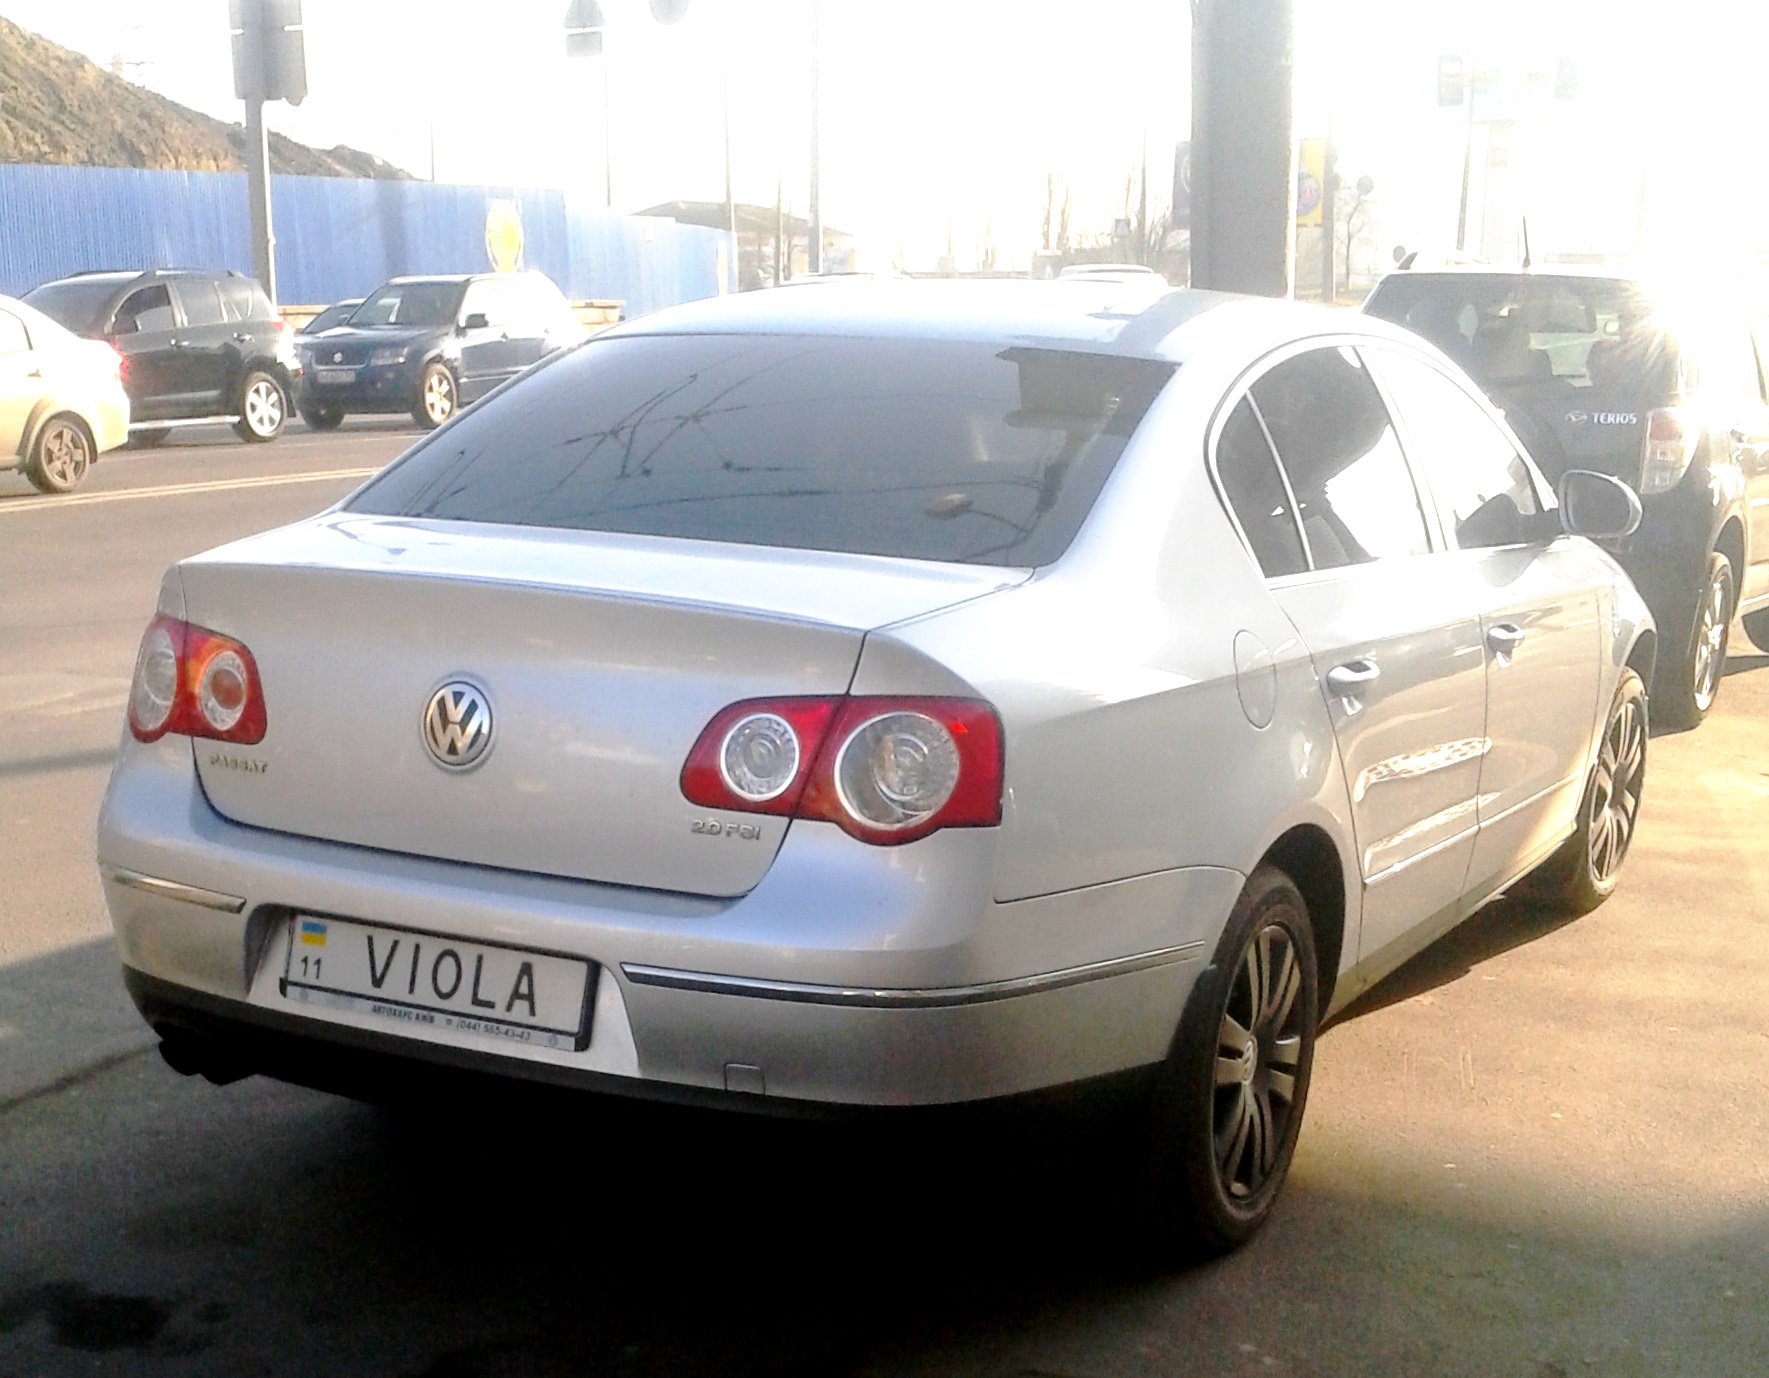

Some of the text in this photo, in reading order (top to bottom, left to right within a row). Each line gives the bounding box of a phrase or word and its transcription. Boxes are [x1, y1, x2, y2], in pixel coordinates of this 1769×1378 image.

[1591, 411, 1637, 425] TERIOS
[300, 955, 322, 980] 11
[367, 934, 536, 1017] VIOLA
